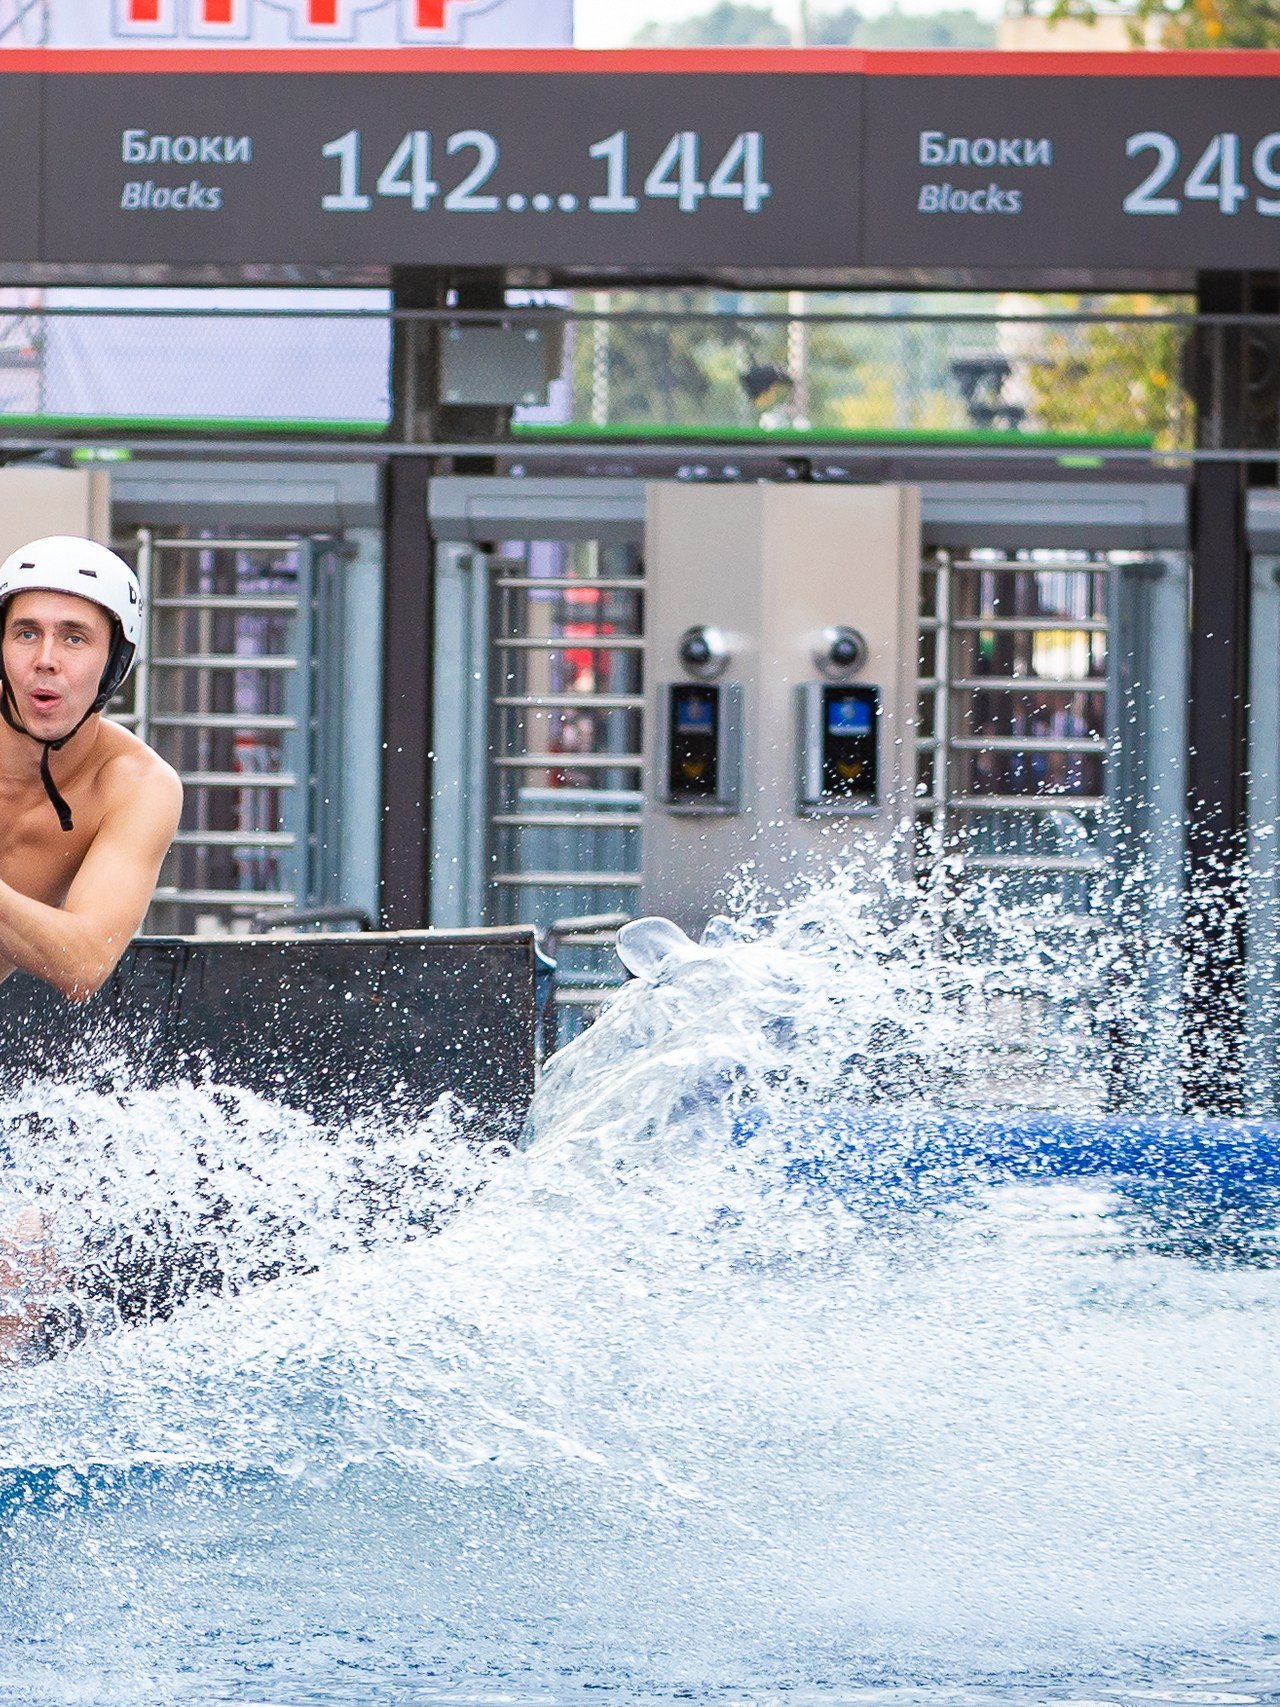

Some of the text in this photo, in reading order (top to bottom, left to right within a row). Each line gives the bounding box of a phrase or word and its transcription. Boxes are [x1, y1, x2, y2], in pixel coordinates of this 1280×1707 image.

[121, 129, 252, 165] Блоки
[919, 131, 1052, 166] Блоки
[321, 129, 771, 213] 142...144
[120, 180, 222, 211] Blocks
[917, 183, 1022, 213] Blocks
